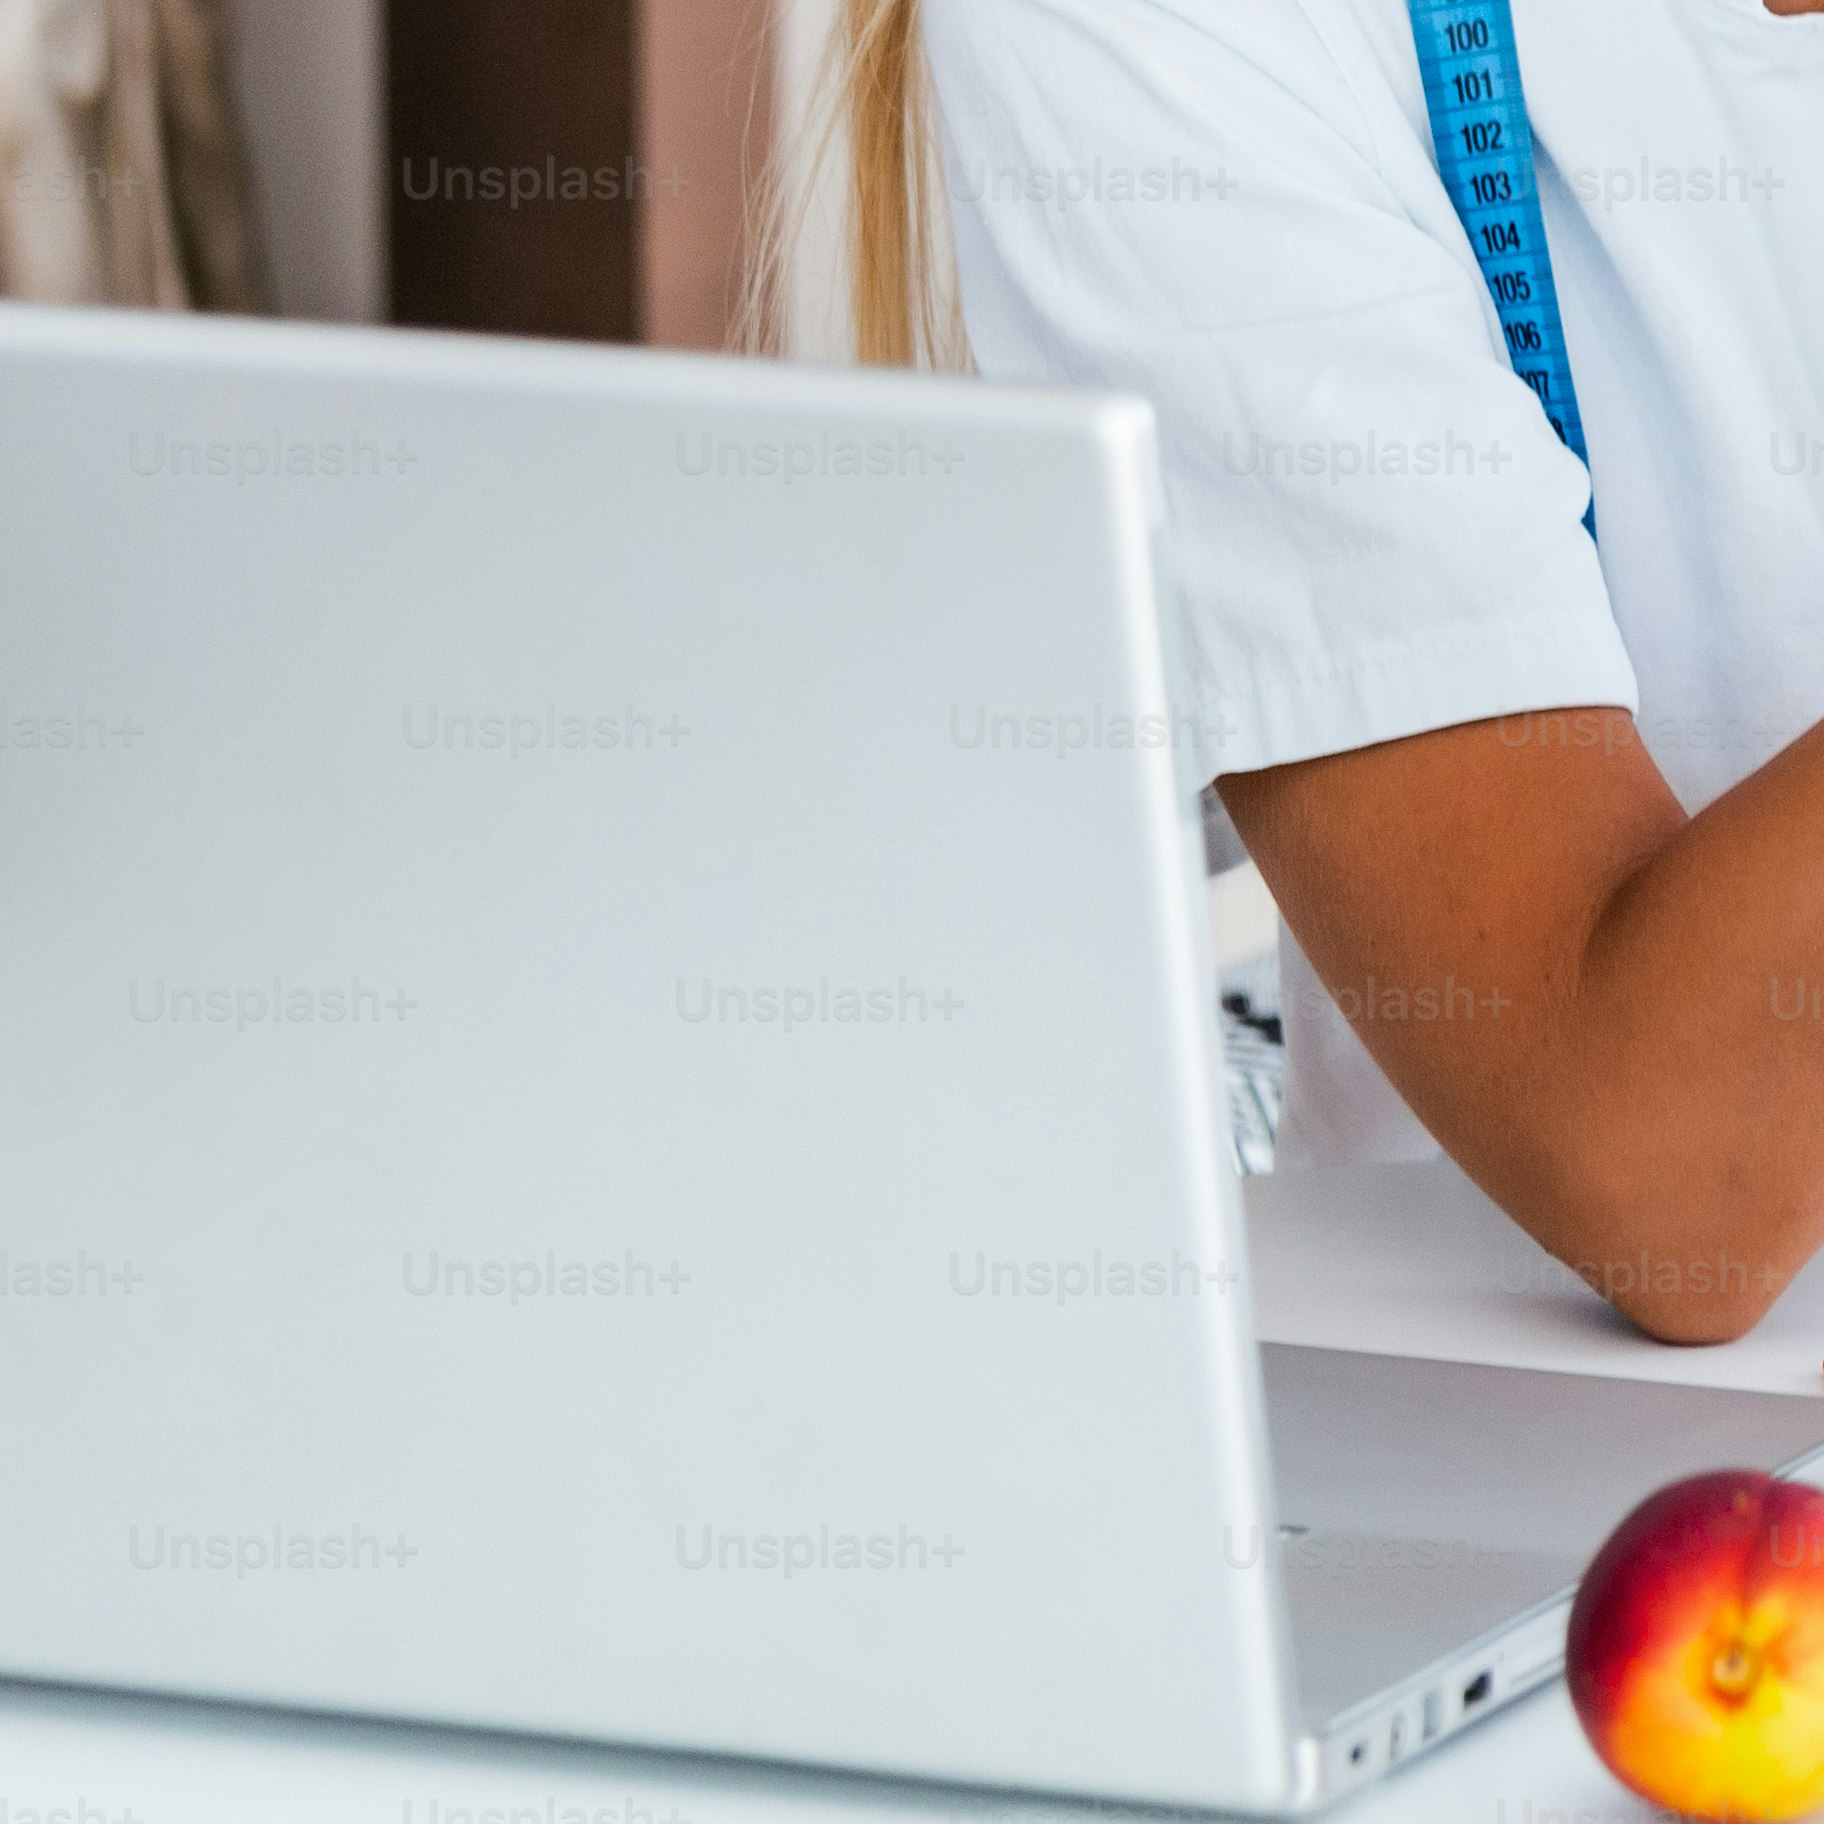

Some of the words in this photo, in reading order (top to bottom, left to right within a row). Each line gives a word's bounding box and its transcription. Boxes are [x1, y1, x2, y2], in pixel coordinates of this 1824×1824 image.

[1445, 19, 1488, 53] 100
[1452, 70, 1493, 103] 101
[1461, 120, 1504, 154] 102
[1472, 171, 1511, 205] 103
[1481, 221, 1521, 254] 104
[1494, 271, 1531, 302] 105
[1505, 321, 1541, 351] 106
